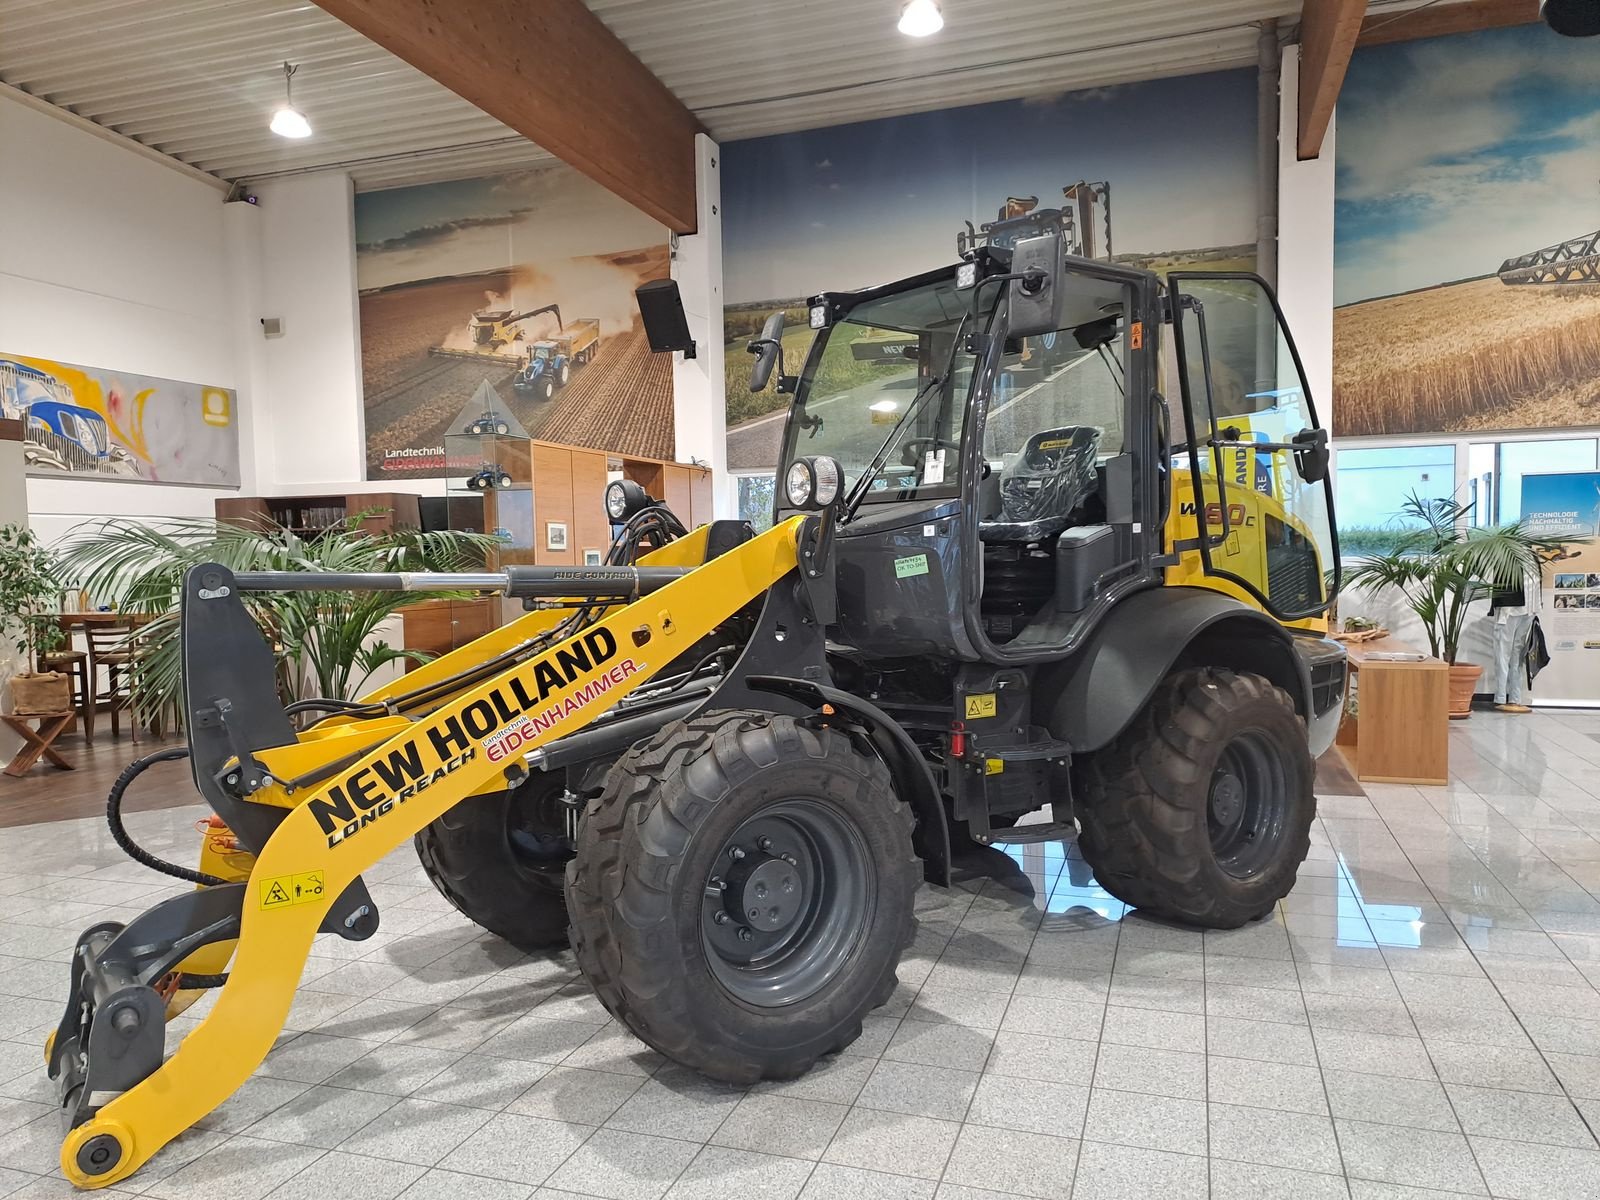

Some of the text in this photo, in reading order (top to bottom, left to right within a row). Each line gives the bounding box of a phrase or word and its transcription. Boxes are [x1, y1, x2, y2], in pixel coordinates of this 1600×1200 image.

[385, 446, 446, 458] Landtechnik
[553, 571, 635, 580] RIDE CONTROL
[307, 626, 617, 836] NEW HOLLAND
[482, 715, 528, 748] Landtechnik
[486, 659, 638, 763] EIDENHAMMER
[327, 746, 476, 850] LONG REACH
